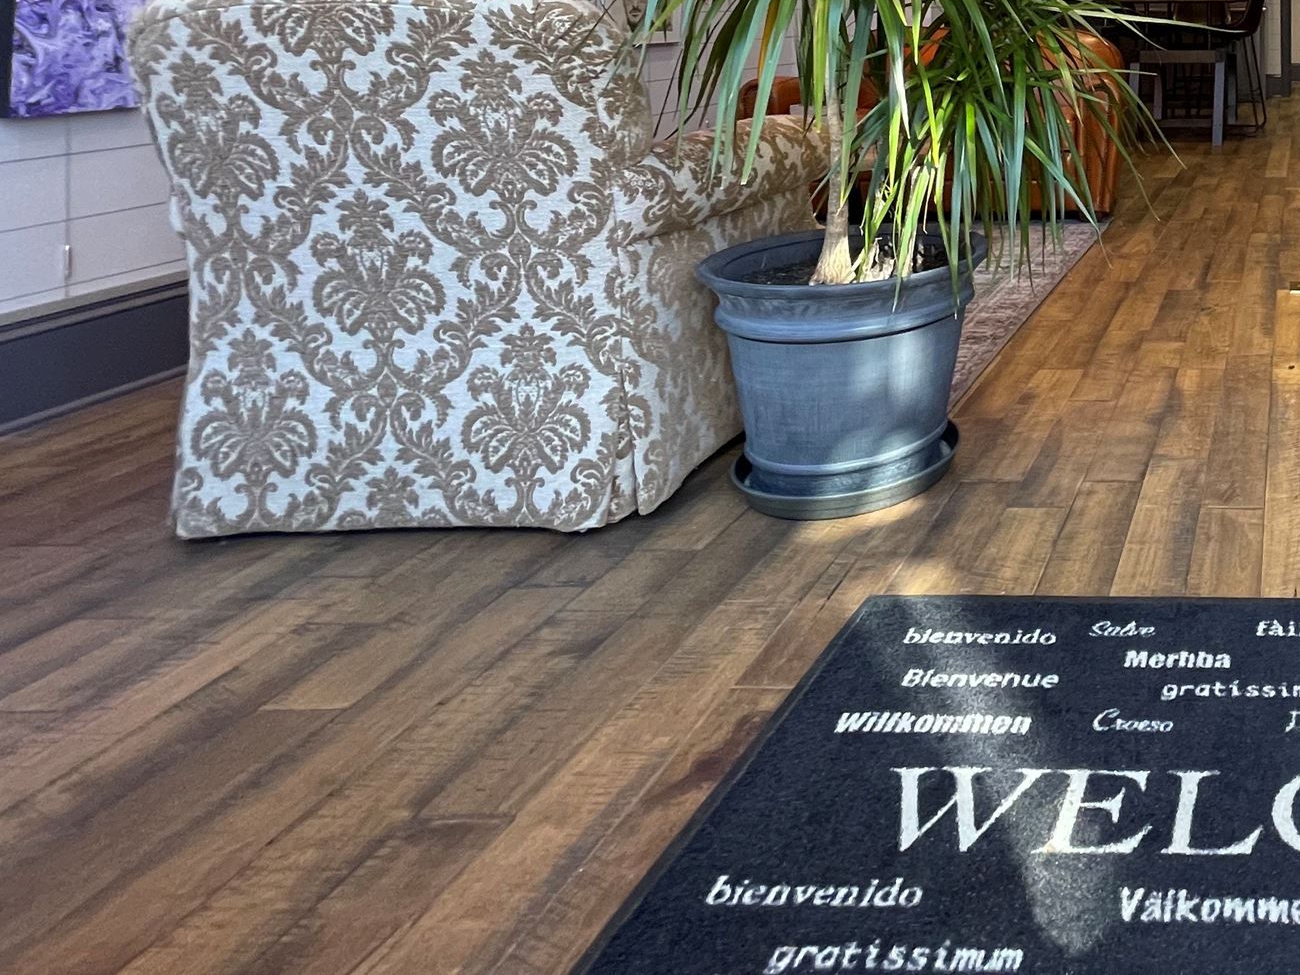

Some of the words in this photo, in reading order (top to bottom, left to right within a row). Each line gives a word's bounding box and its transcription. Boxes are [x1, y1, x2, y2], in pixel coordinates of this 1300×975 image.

[903, 628, 1057, 646] bienvenido
[901, 668, 1060, 689] Bienvenue
[834, 711, 1033, 735] Willkommen
[705, 875, 924, 908] bienvenido
[762, 937, 1025, 975] gratissimum
